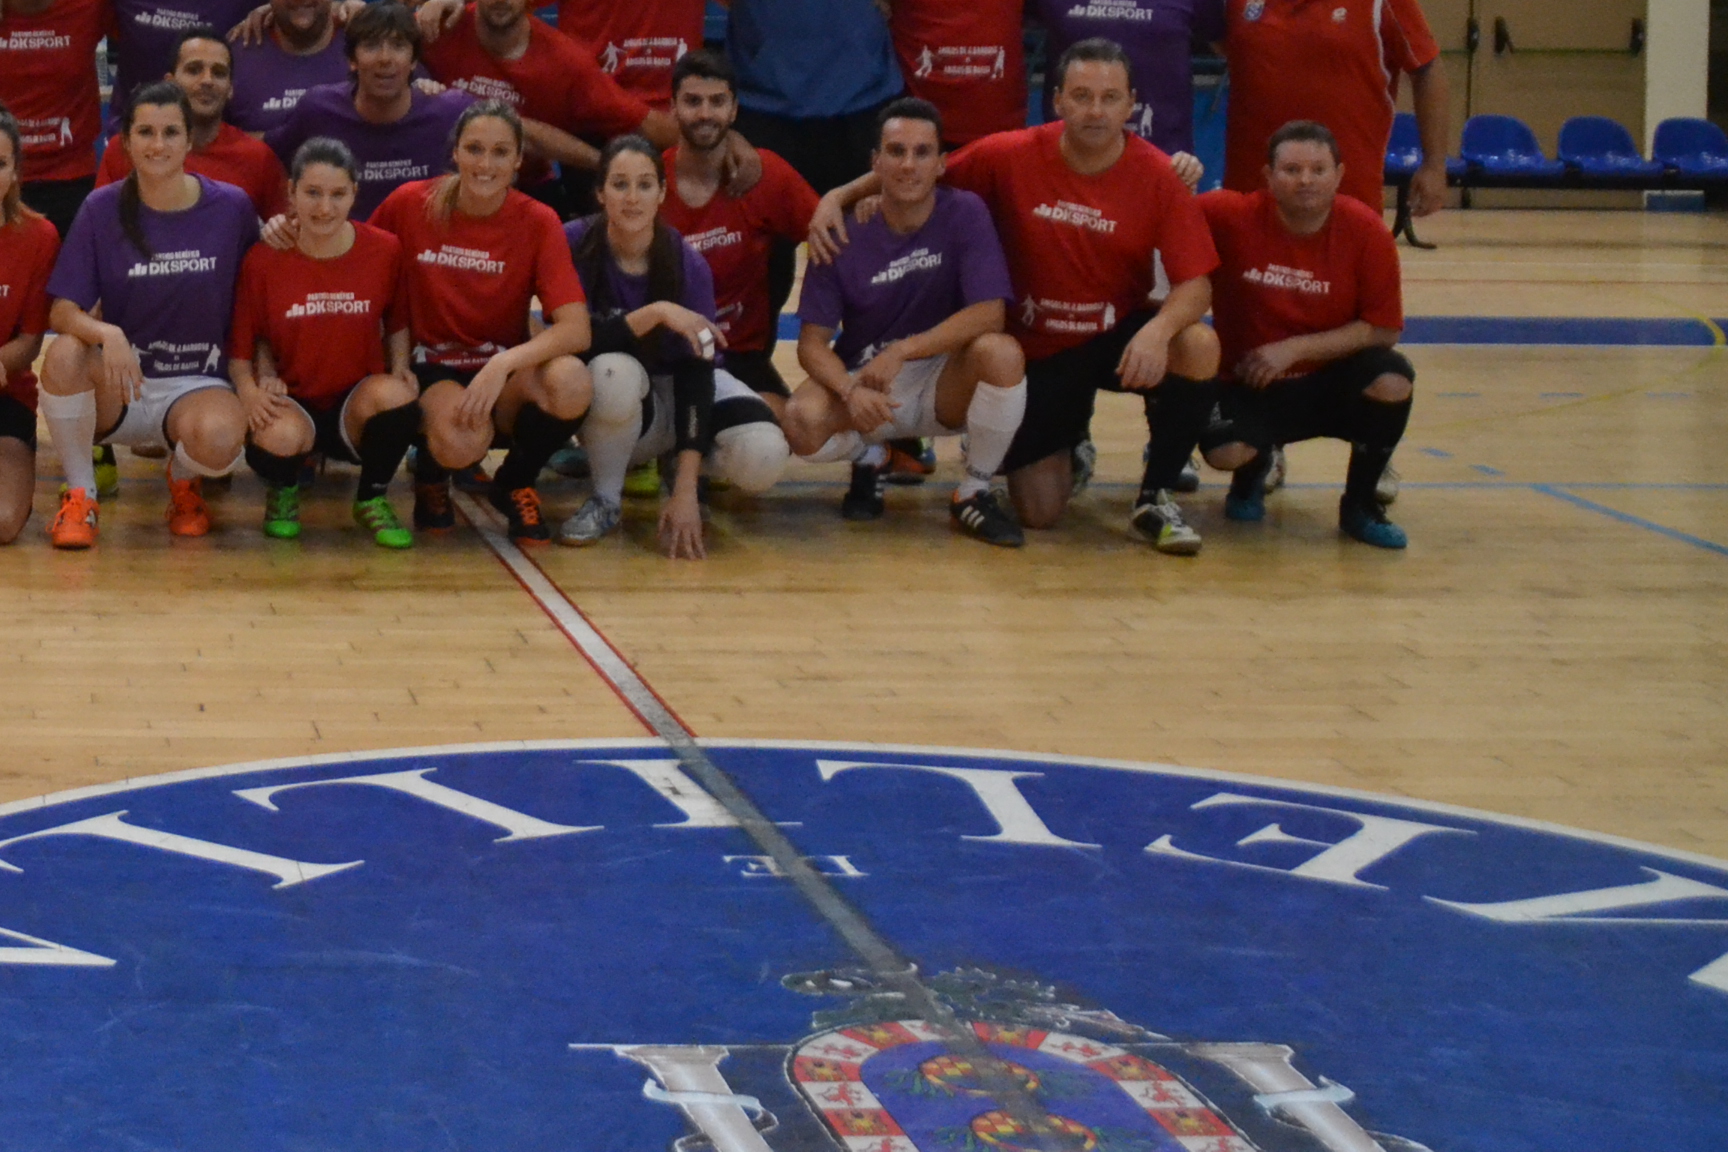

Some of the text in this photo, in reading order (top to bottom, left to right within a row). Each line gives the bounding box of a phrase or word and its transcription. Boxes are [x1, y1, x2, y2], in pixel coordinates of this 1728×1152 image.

[1086, 4, 1153, 20] DKSPORT
[9, 35, 71, 49] DKSPORT
[364, 165, 429, 180] DKSPORT
[692, 231, 742, 253] KSPORT
[149, 257, 217, 275] DKSPORT
[437, 253, 505, 274] DKSPORT
[1263, 272, 1331, 294] DKSPORT
[306, 299, 371, 315] DKSPORT
